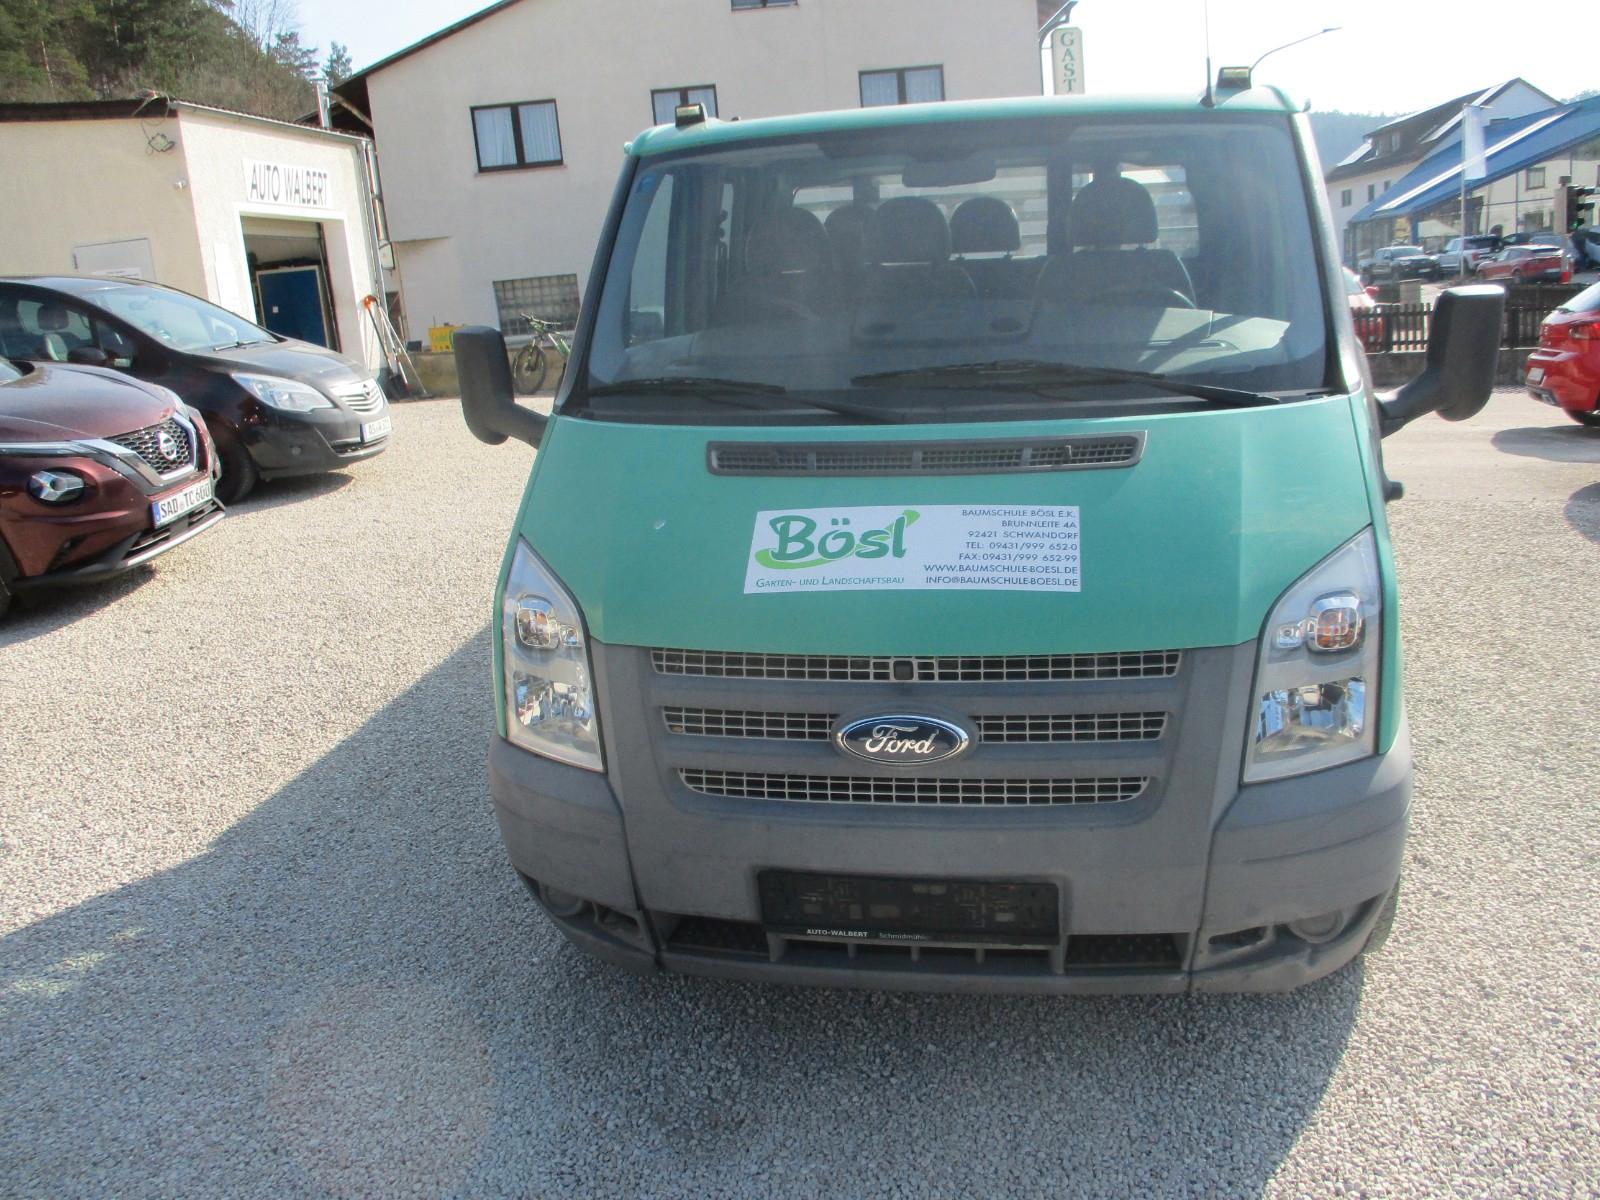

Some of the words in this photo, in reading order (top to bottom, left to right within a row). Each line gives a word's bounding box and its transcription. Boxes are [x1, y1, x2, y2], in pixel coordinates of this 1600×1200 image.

[1061, 32, 1076, 92] GAST
[250, 162, 280, 202] AUTO
[283, 167, 328, 206] WALBERT
[160, 499, 178, 518] SAD
[184, 491, 195, 507] TC
[962, 508, 1028, 517] BAUMSCHULE
[1031, 508, 1055, 518] BÖSL
[1002, 520, 1060, 529] BRUNNLEITE
[1063, 521, 1077, 529] 4A
[769, 515, 907, 560] Bösl
[968, 530, 998, 538] 92421
[1002, 530, 1079, 540] SCHWANDORF
[989, 542, 1045, 550] 09431/999
[1048, 543, 1078, 551] 652-0
[982, 553, 1038, 562] 09431/999
[1042, 555, 1078, 563] 652-99
[924, 564, 1078, 575] WWW.BAUMSCHULE-BOESL.DE
[755, 577, 797, 588] GARTEN-
[821, 575, 905, 586] LANDSCHAFTSBAU
[925, 576, 1079, 587] INFO@BAUMSCHULE-BOESL.DE
[864, 724, 940, 754] Ford
[806, 929, 868, 937] AUTO-WALBERT
